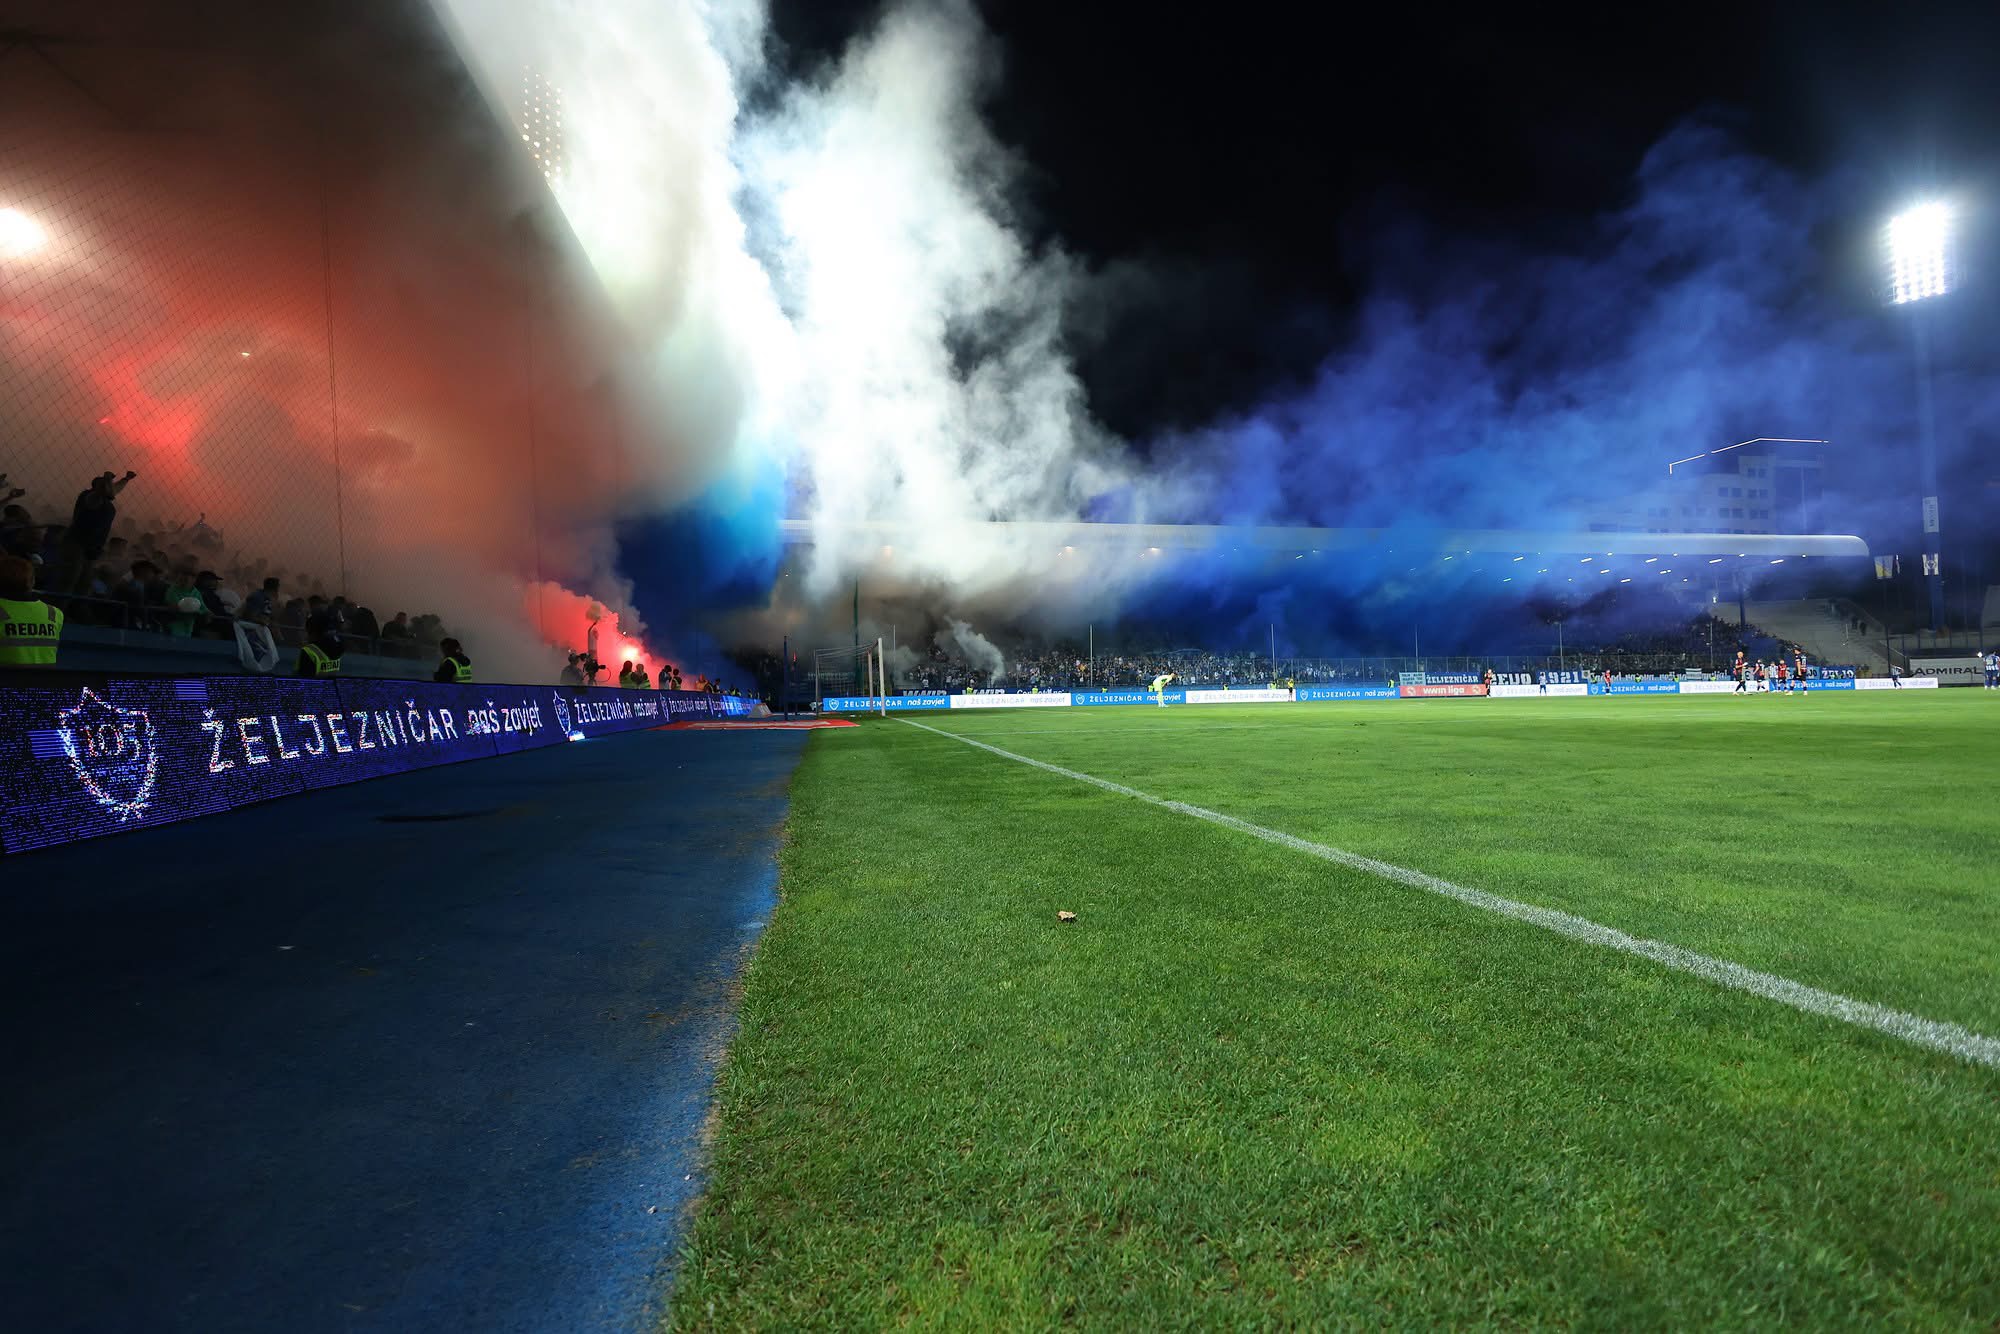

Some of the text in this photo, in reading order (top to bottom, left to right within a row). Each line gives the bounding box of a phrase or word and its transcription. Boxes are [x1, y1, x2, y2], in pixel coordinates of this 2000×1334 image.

[5, 623, 55, 636] REDAR
[1915, 666, 1984, 676] ADMIRAL
[1426, 674, 1479, 684] ŽELJEZNIČAR
[1377, 689, 1396, 698] zavjet
[1448, 686, 1465, 695] liga
[844, 699, 902, 708] ŽELJEZNČAR
[921, 698, 945, 708] zavjet
[1089, 694, 1143, 702] ŽELJEZNIČAR
[574, 698, 632, 724] ŽELJEZNIČAR
[201, 699, 458, 773] ŽELJEZNIČAR
[500, 699, 543, 737] zavjet
[83, 724, 141, 760] 105
